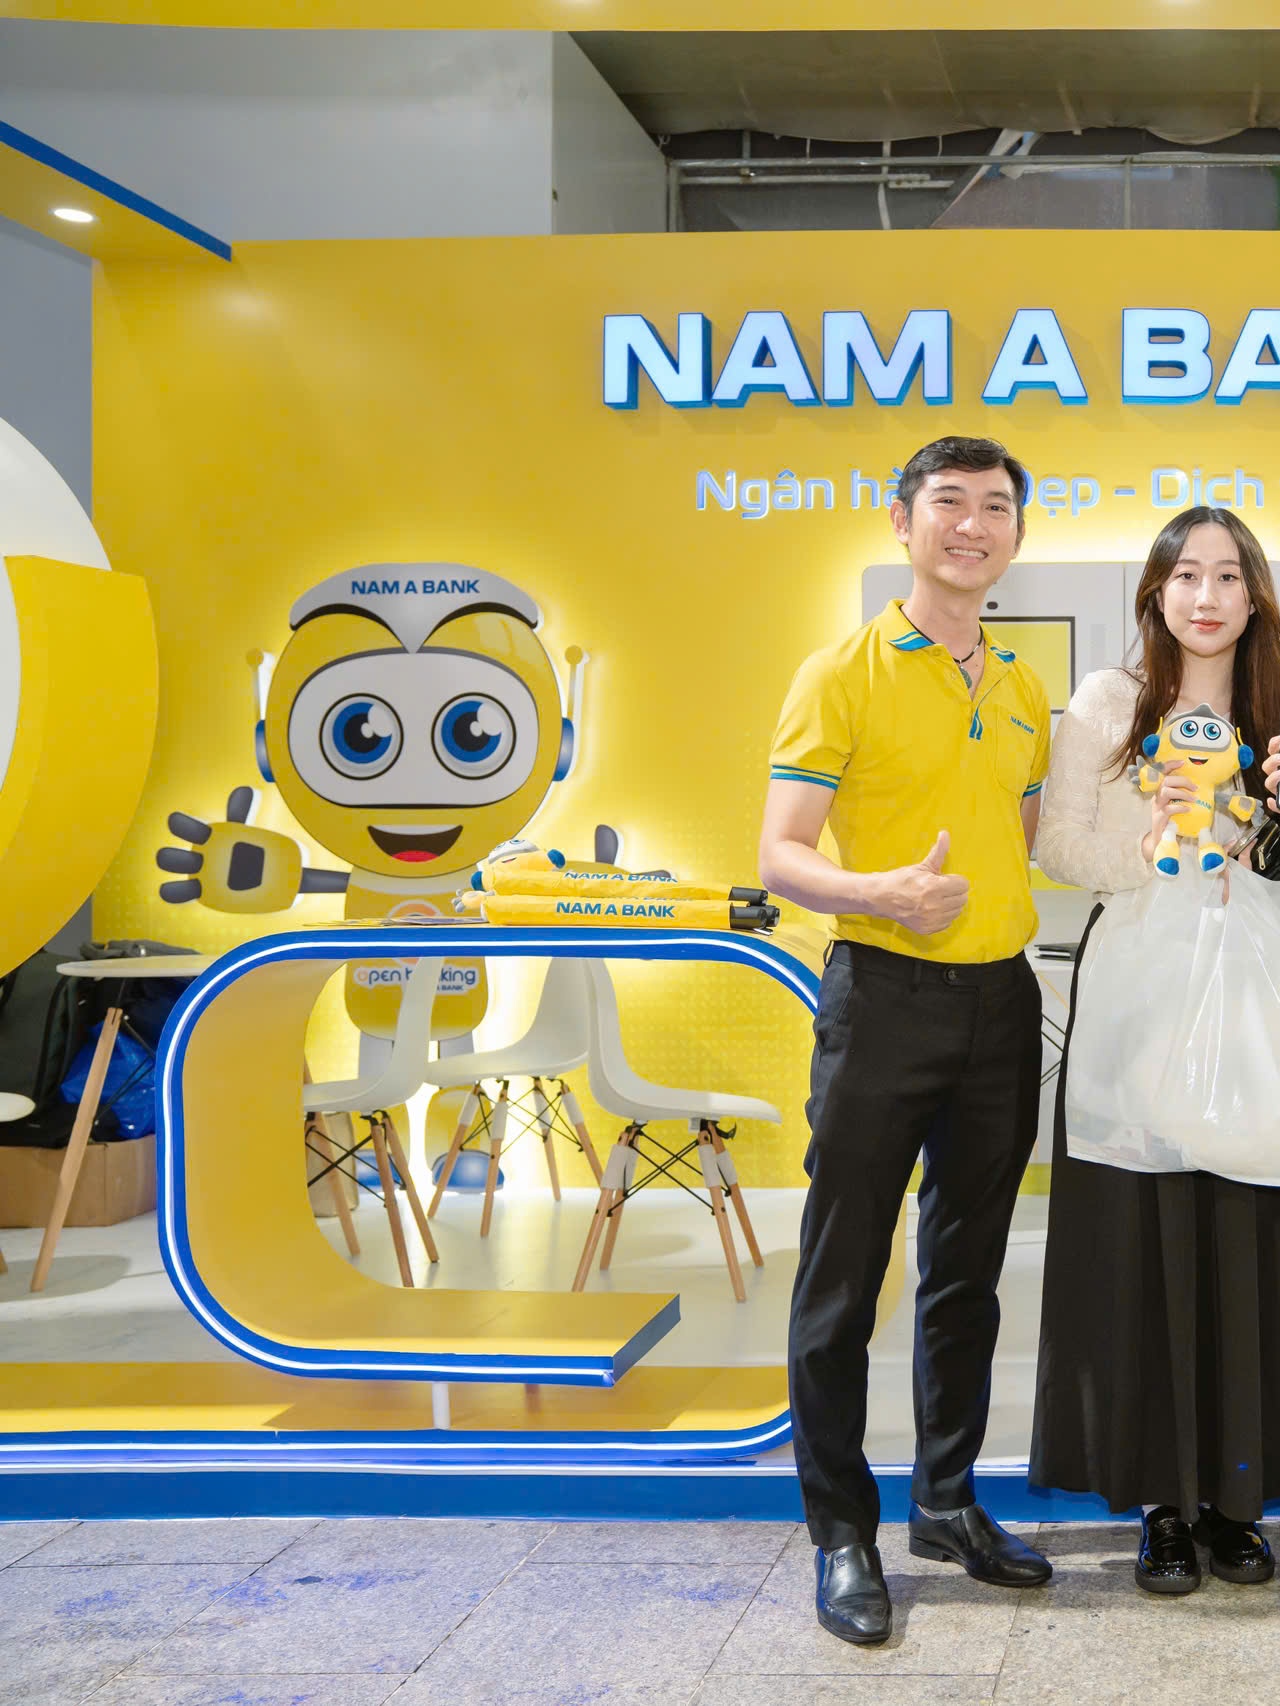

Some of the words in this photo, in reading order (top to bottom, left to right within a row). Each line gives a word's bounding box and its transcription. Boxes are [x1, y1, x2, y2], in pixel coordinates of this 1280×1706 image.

[603, 310, 952, 409] NAM
[981, 308, 1088, 406] A
[696, 468, 833, 519] Ngân
[851, 467, 903, 509] hà
[351, 580, 400, 594] NAM
[404, 580, 418, 594] A
[422, 579, 480, 593] BANK
[564, 872, 608, 880] NAM
[611, 873, 624, 881] A
[556, 902, 601, 914] NAM
[605, 904, 618, 915] A
[622, 904, 675, 918] BANK
[357, 970, 401, 985] open
[405, 967, 476, 985] bking
